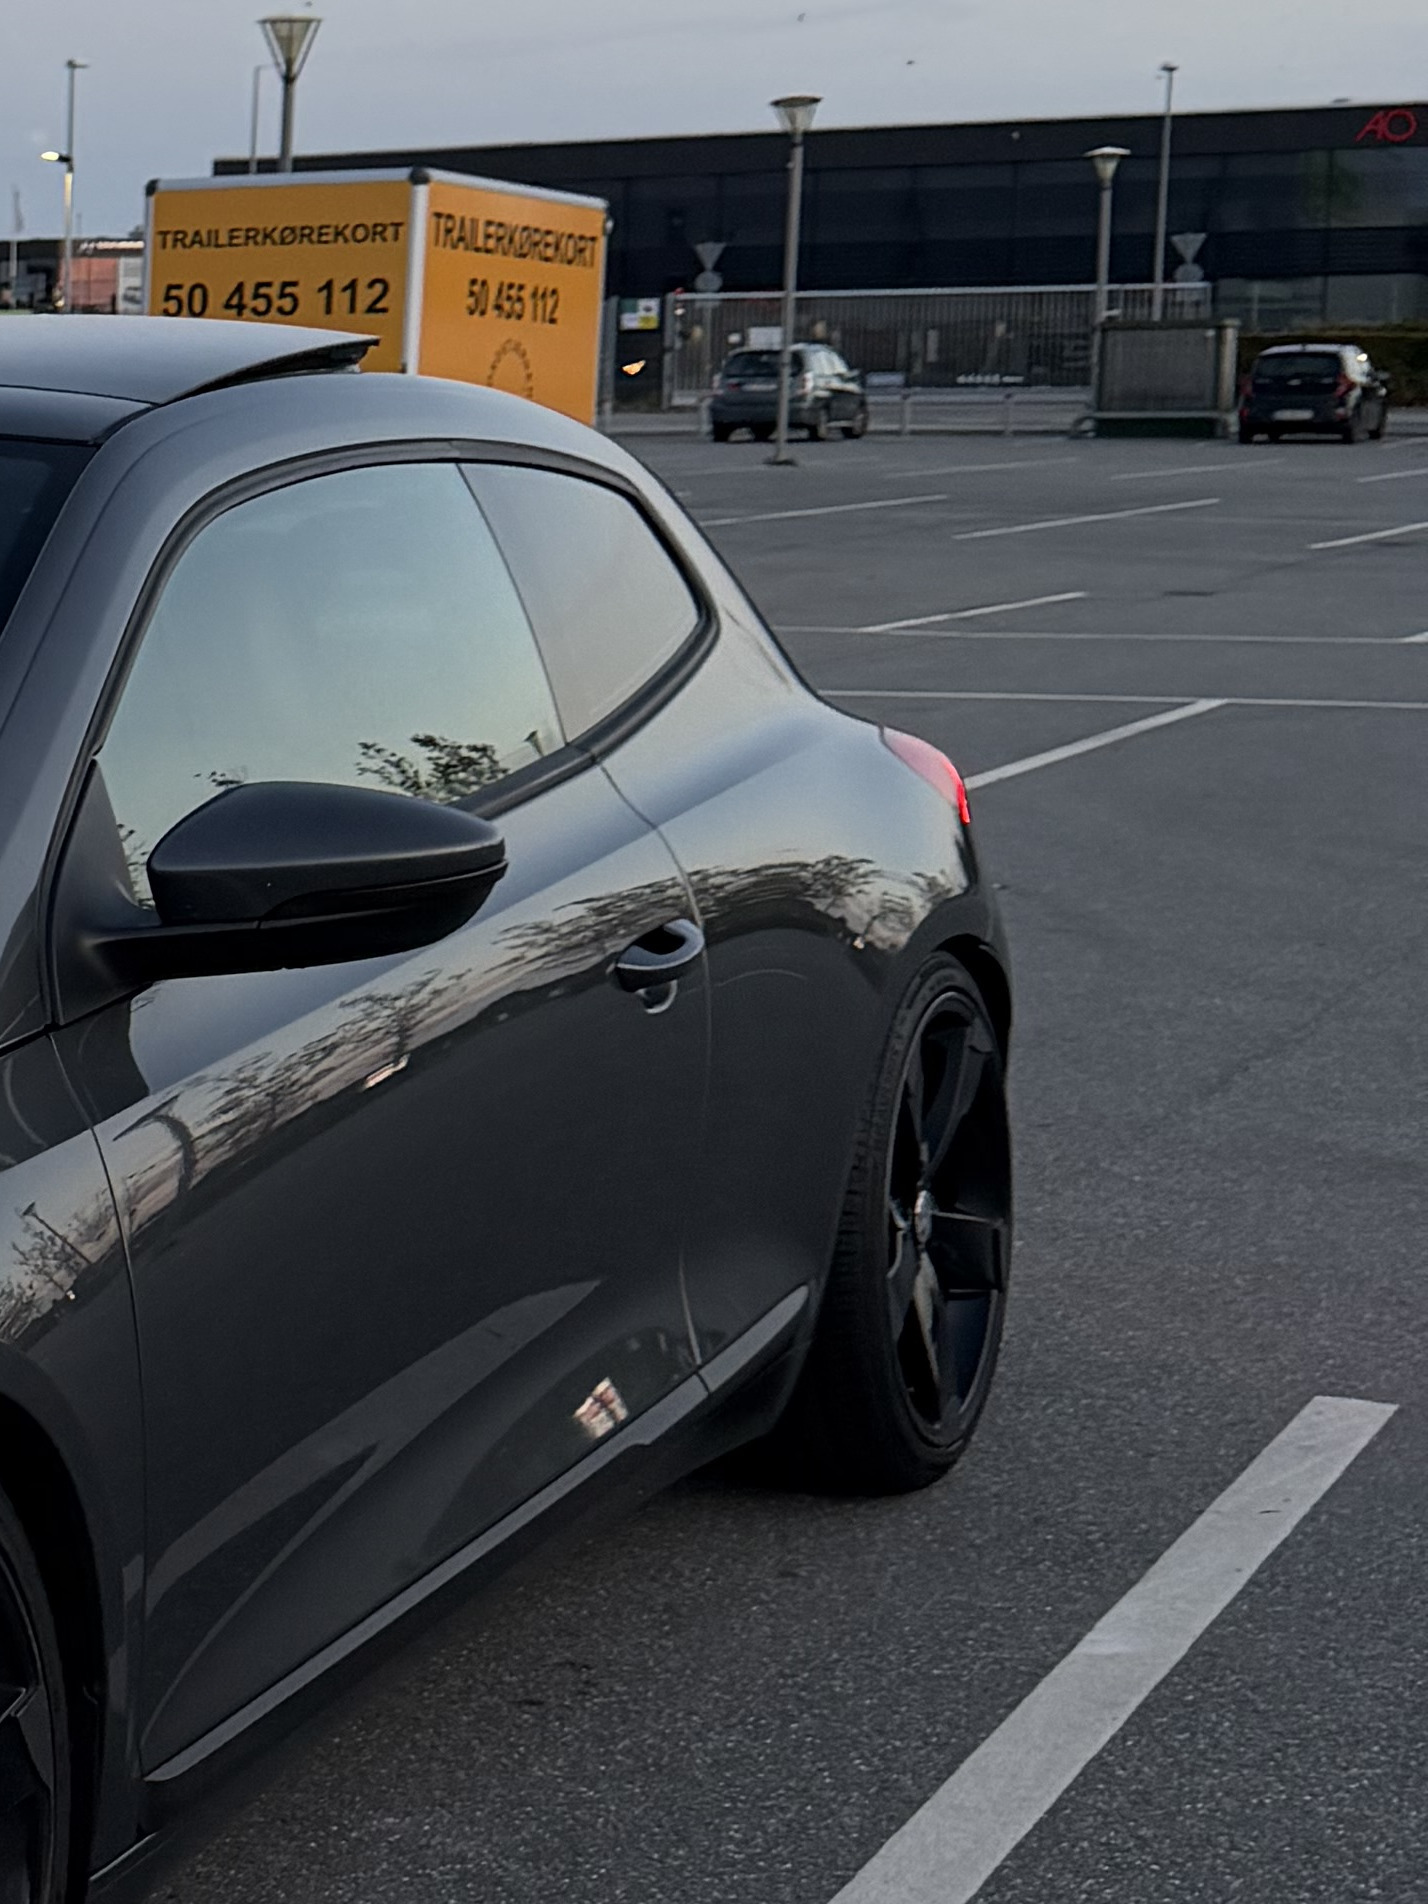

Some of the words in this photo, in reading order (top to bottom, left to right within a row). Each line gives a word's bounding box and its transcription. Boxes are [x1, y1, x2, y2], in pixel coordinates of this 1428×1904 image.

[157, 221, 405, 250] TRAILERKØREKORT
[433, 211, 598, 268] TRAILERKØREKORT
[162, 282, 209, 317] 50
[222, 280, 300, 317] 455
[316, 277, 391, 315] 112
[466, 277, 491, 317] 50
[493, 280, 526, 321] 455
[530, 284, 560, 325] 112
